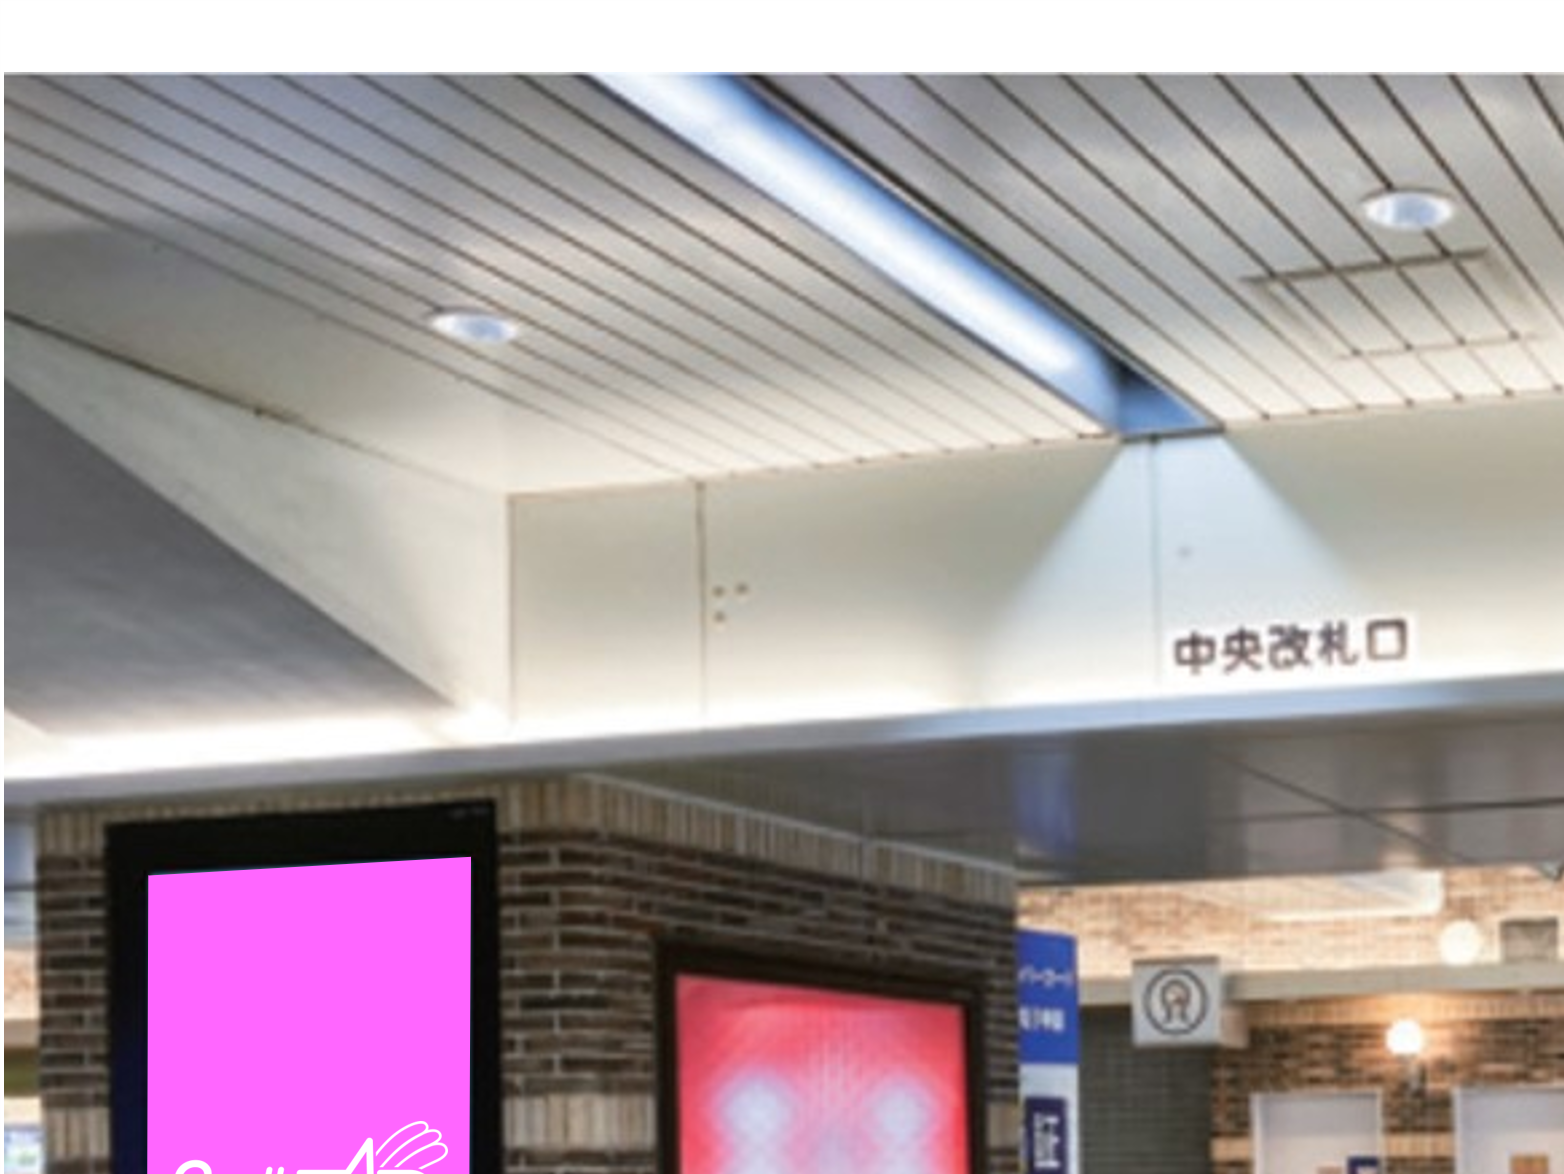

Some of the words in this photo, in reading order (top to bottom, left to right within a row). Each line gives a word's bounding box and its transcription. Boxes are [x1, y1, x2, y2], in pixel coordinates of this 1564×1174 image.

[1173, 617, 1409, 676] 中央改札口
